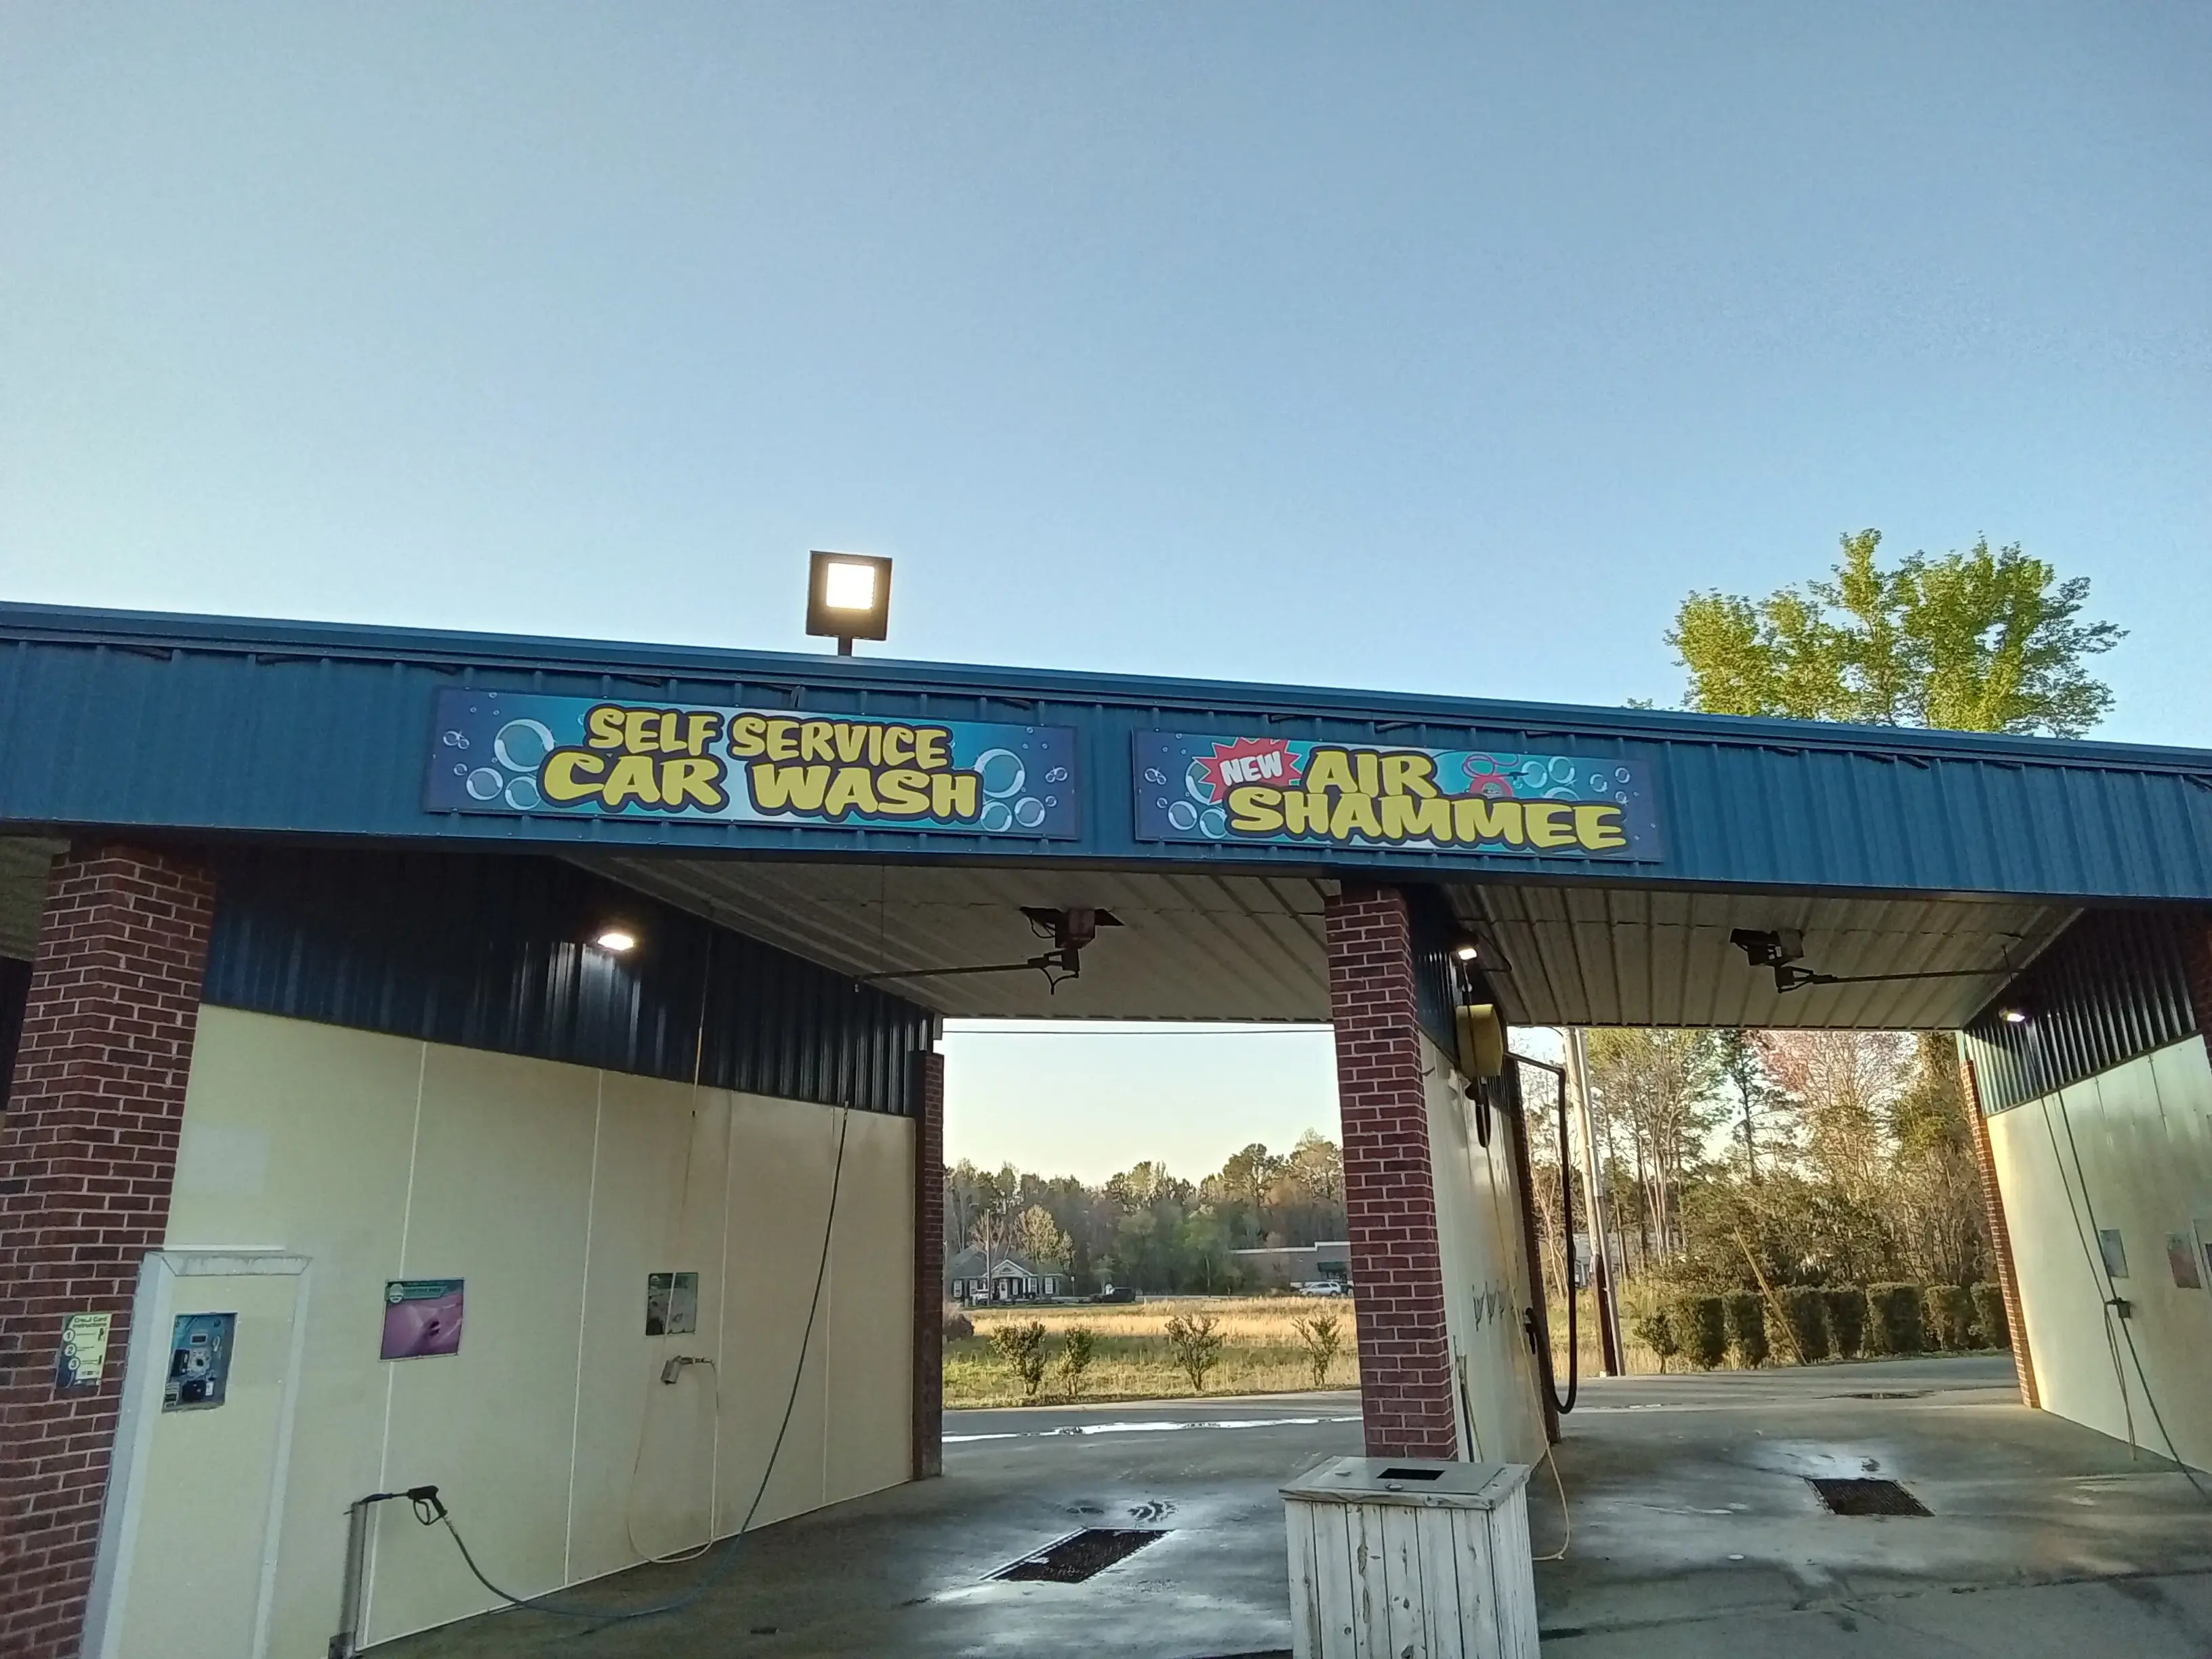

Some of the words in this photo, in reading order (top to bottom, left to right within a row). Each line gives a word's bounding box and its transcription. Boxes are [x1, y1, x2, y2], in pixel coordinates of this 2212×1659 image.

[588, 708, 717, 755] SELF
[731, 714, 948, 769] SERVICE
[1219, 750, 1283, 786] NEW
[544, 751, 723, 805] CAR
[752, 764, 977, 816] WASH
[1307, 750, 1437, 798] AIR
[1228, 787, 1628, 851] SHAMMEE
